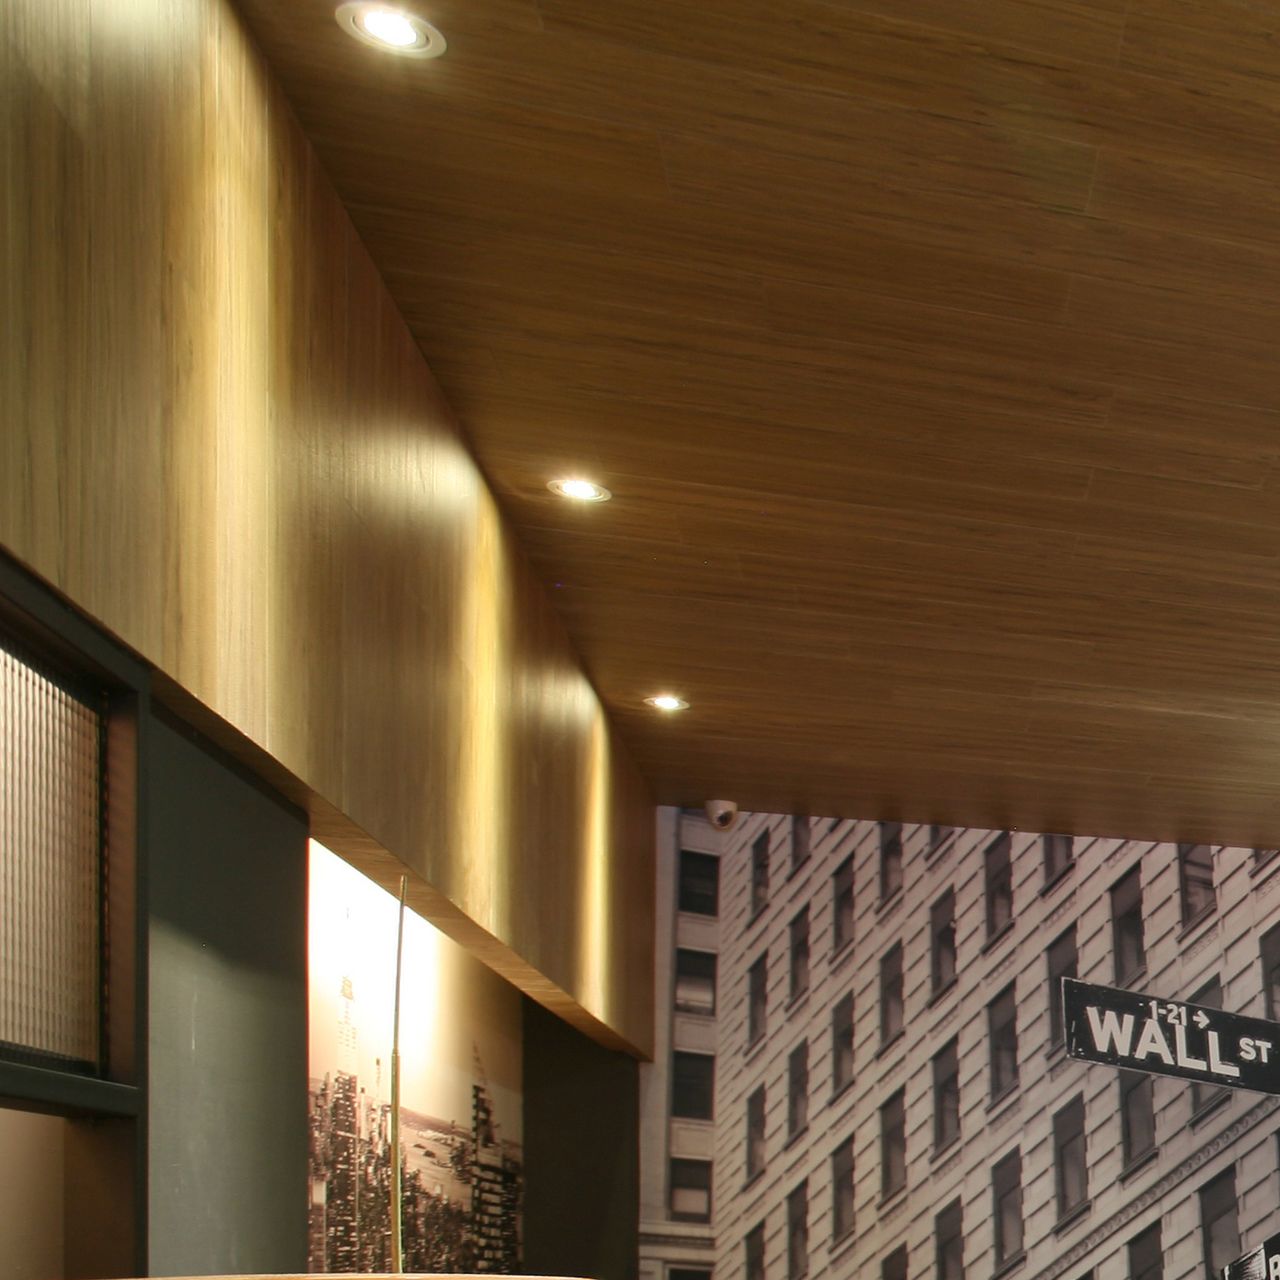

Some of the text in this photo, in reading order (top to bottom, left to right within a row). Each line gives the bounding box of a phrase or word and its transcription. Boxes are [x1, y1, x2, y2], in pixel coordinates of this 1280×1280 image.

[1149, 1000, 1187, 1026] 1-21
[1086, 1006, 1271, 1077] WALL ST
